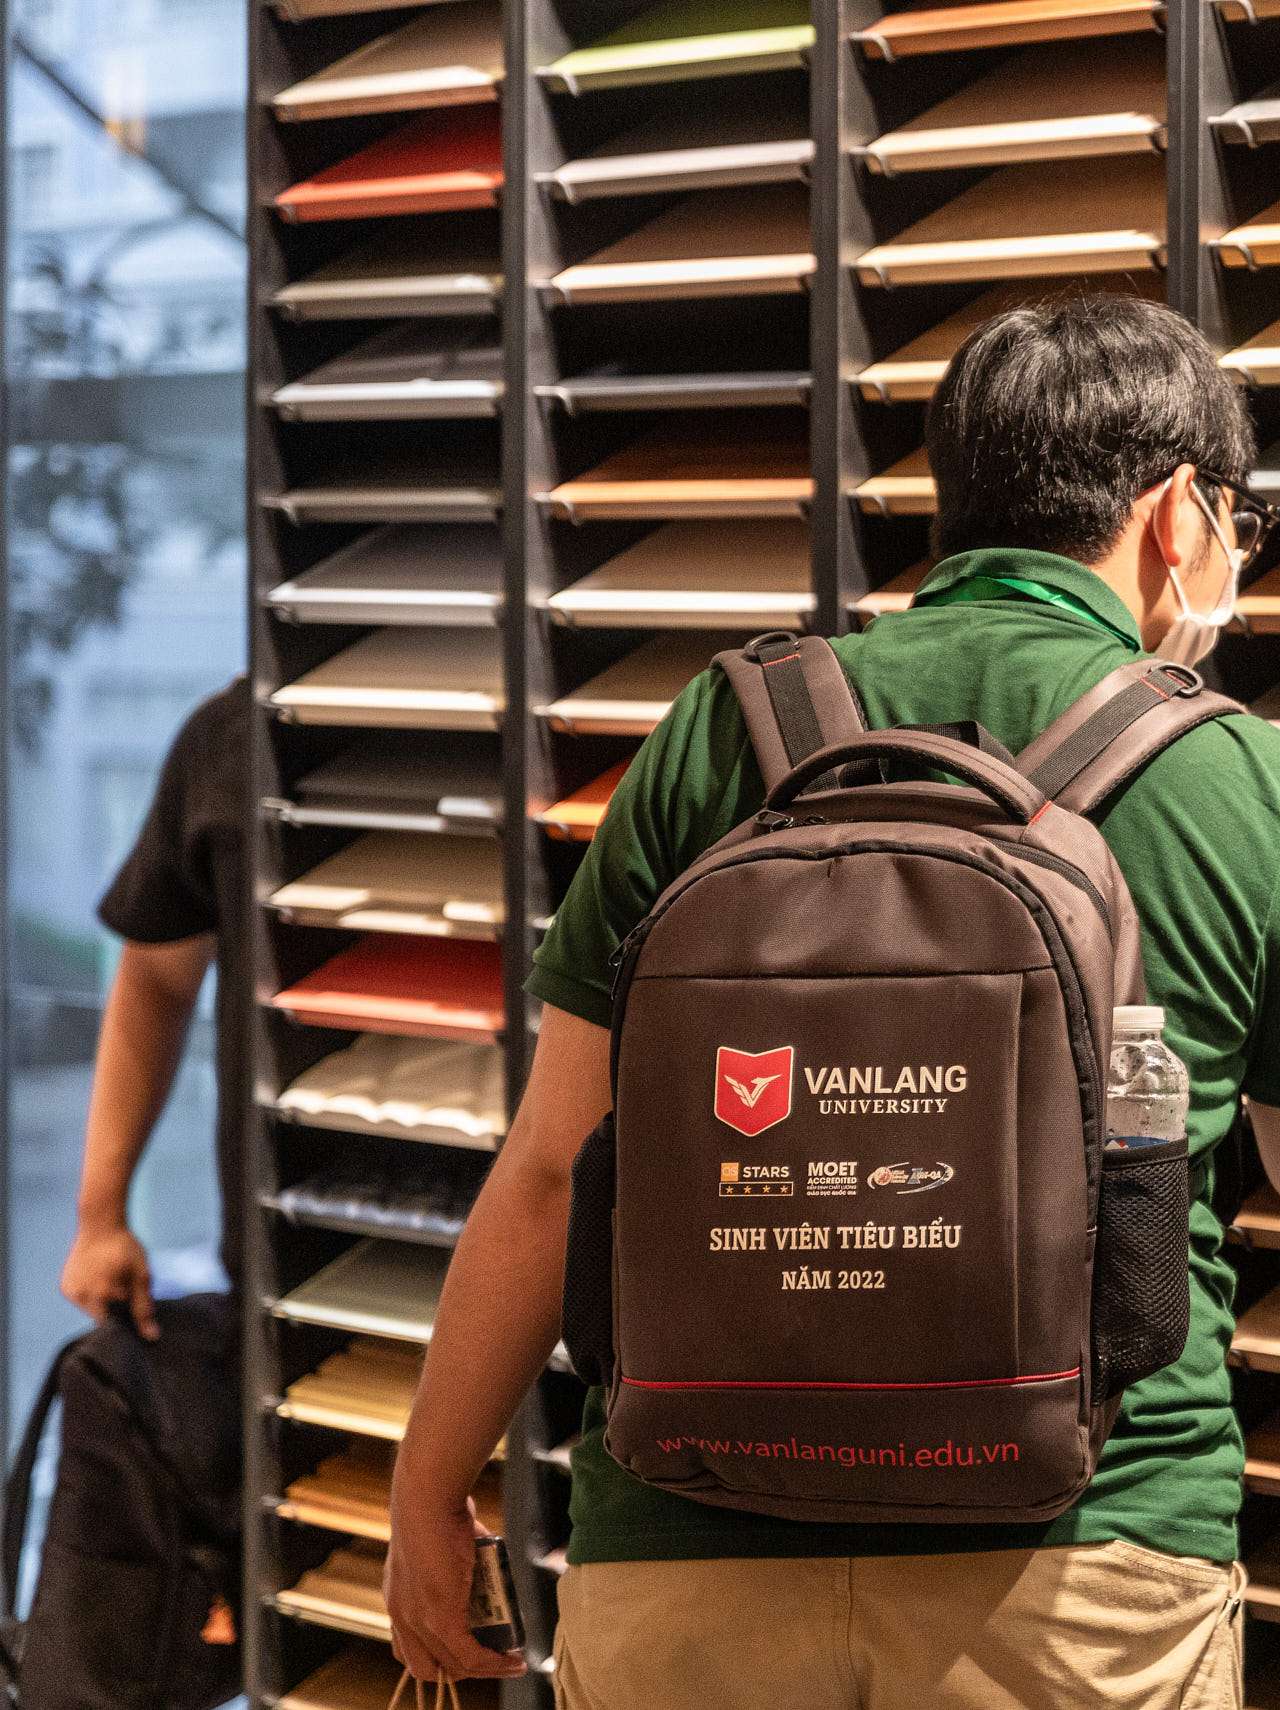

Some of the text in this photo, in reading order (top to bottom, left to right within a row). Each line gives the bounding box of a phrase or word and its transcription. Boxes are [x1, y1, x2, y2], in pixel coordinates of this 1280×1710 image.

[804, 1065, 967, 1095] VANLANG
[819, 1099, 948, 1115] UNIVERSITY
[742, 1166, 790, 1178] STARS
[807, 1161, 858, 1177] MOET
[807, 1177, 857, 1185] ACCREDITED
[709, 1217, 962, 1251] SINH VIÊN TIÊU BIỂU
[781, 1266, 886, 1290] NĂM 2022
[656, 1433, 1020, 1468] www.vanlanguni.edu.vn
